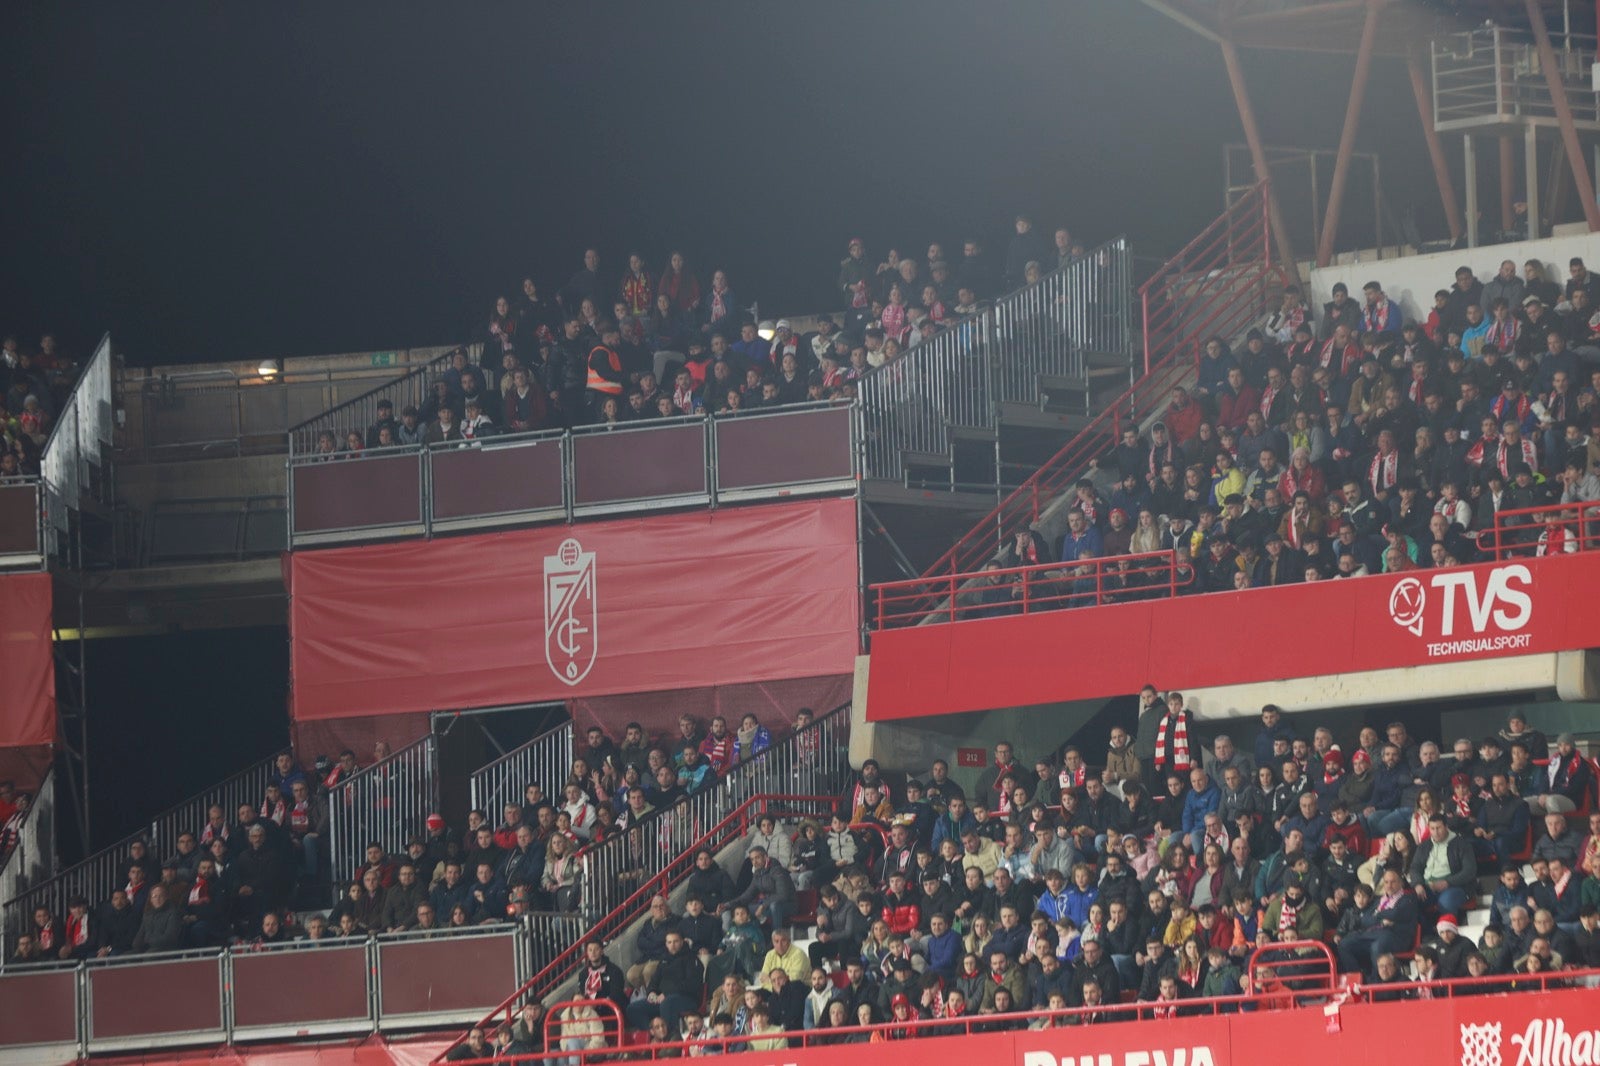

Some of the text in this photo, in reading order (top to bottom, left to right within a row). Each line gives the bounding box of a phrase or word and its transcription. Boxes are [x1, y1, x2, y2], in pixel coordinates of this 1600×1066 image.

[1431, 565, 1532, 636] TVS
[1427, 634, 1532, 656] TECHVISUALSPORT
[1511, 1018, 1600, 1066] Alha
